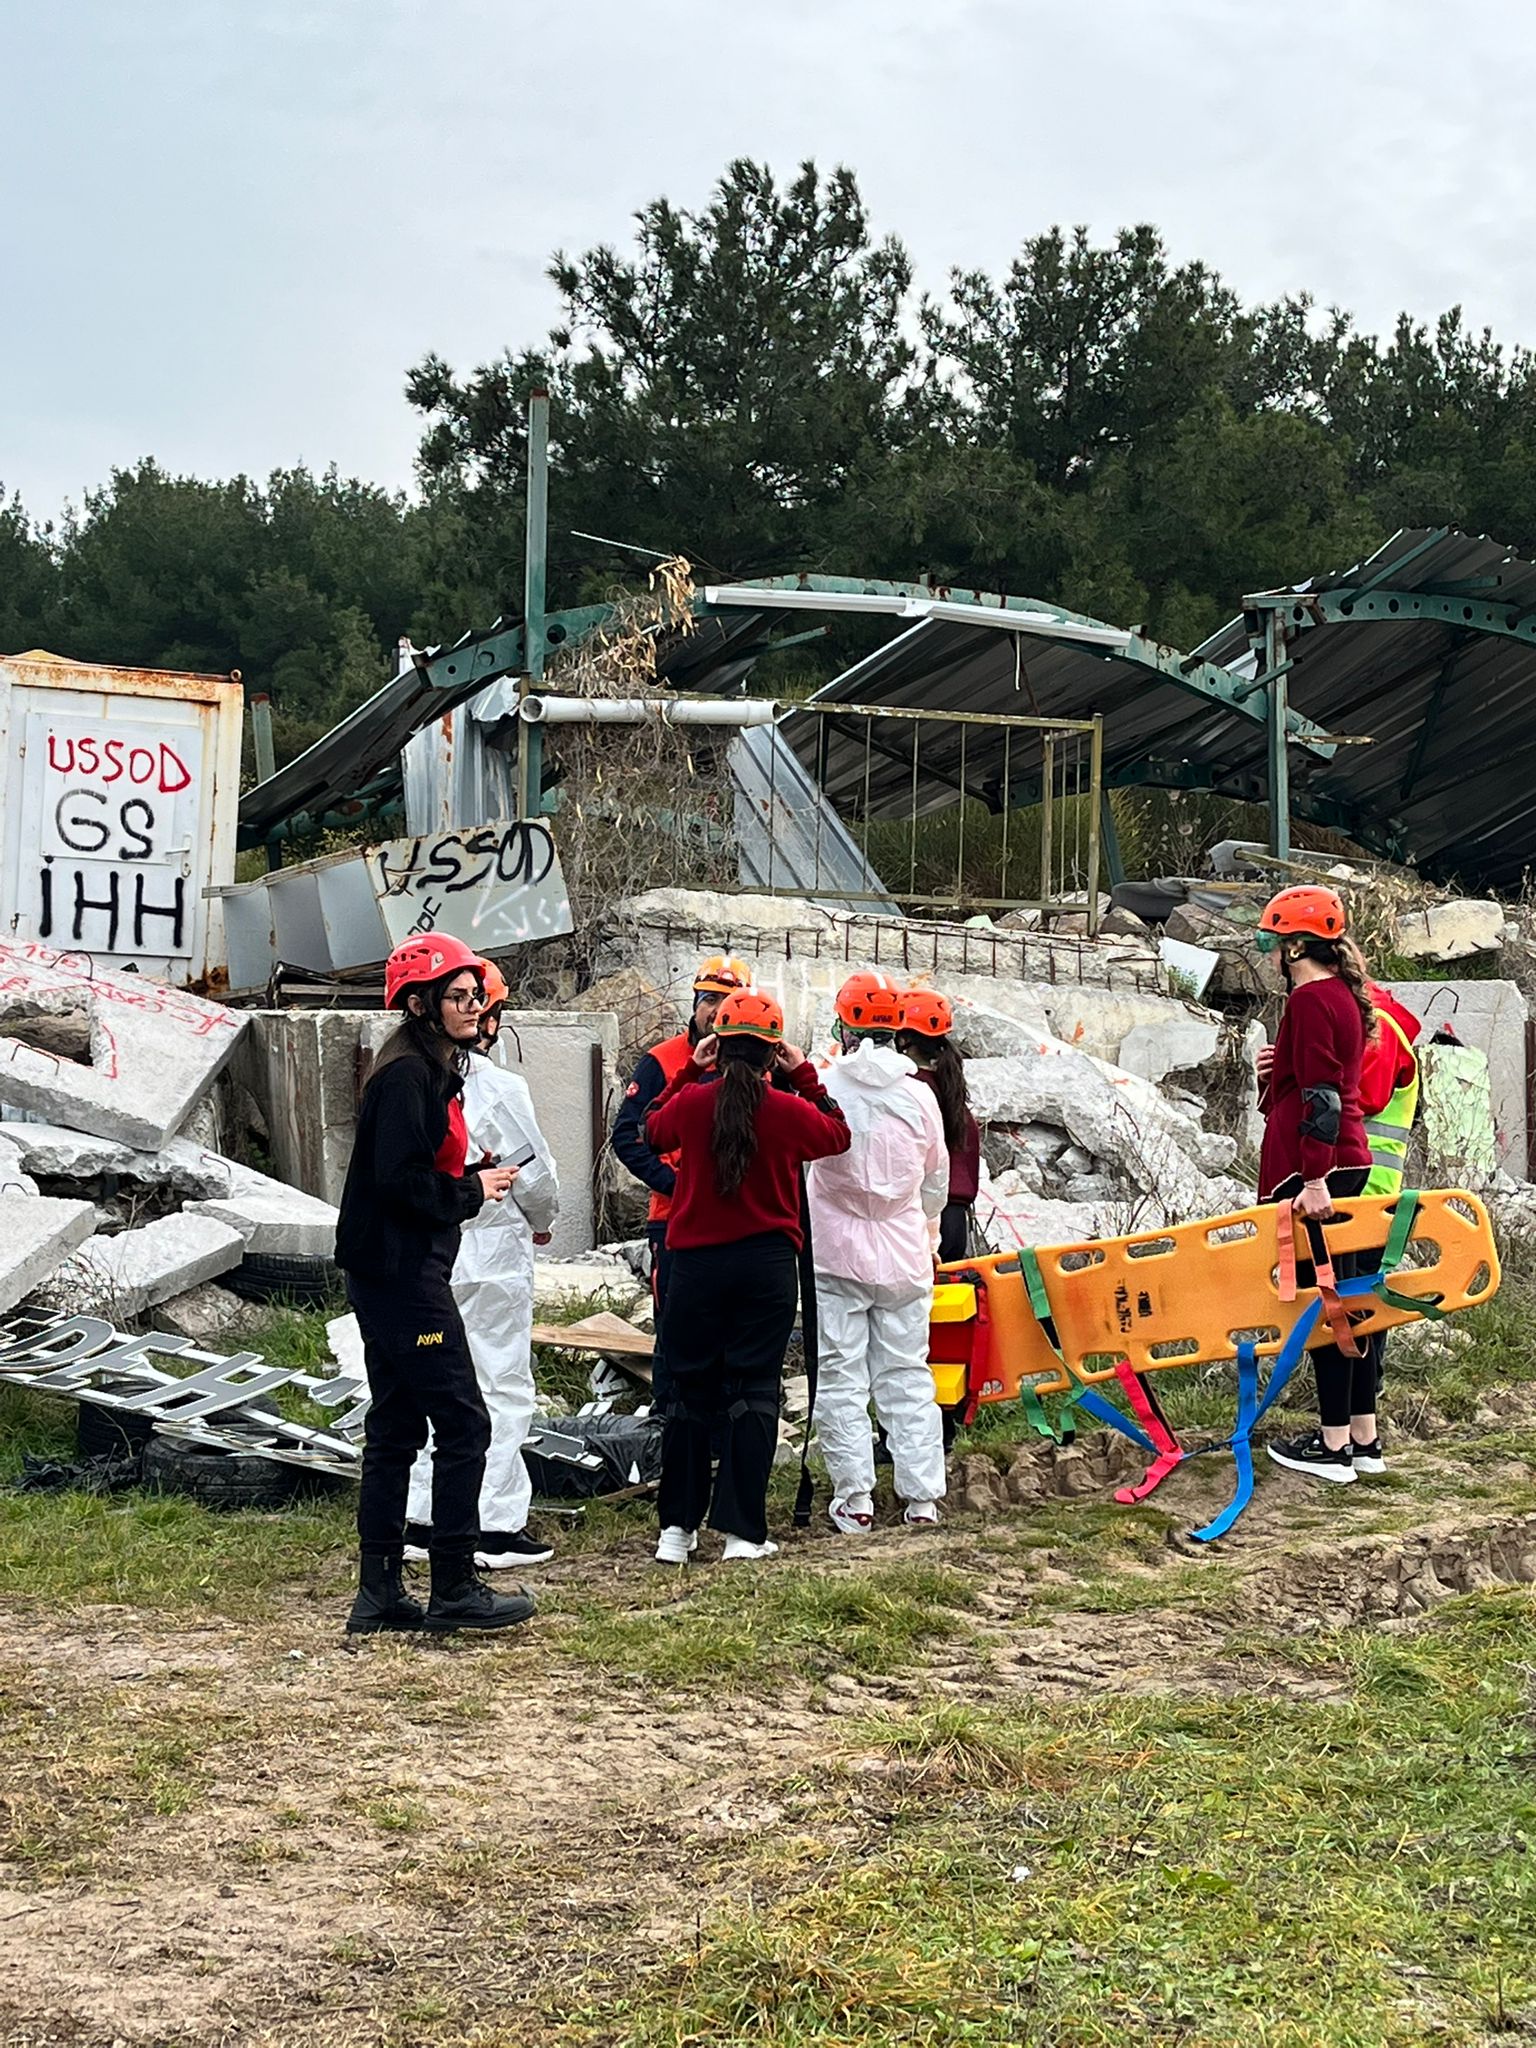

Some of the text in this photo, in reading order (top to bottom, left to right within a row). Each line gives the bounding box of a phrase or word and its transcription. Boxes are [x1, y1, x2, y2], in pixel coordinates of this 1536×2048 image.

[48, 735, 191, 793] USSOD
[55, 788, 154, 860] GS
[416, 1330, 444, 1347] AYAY
